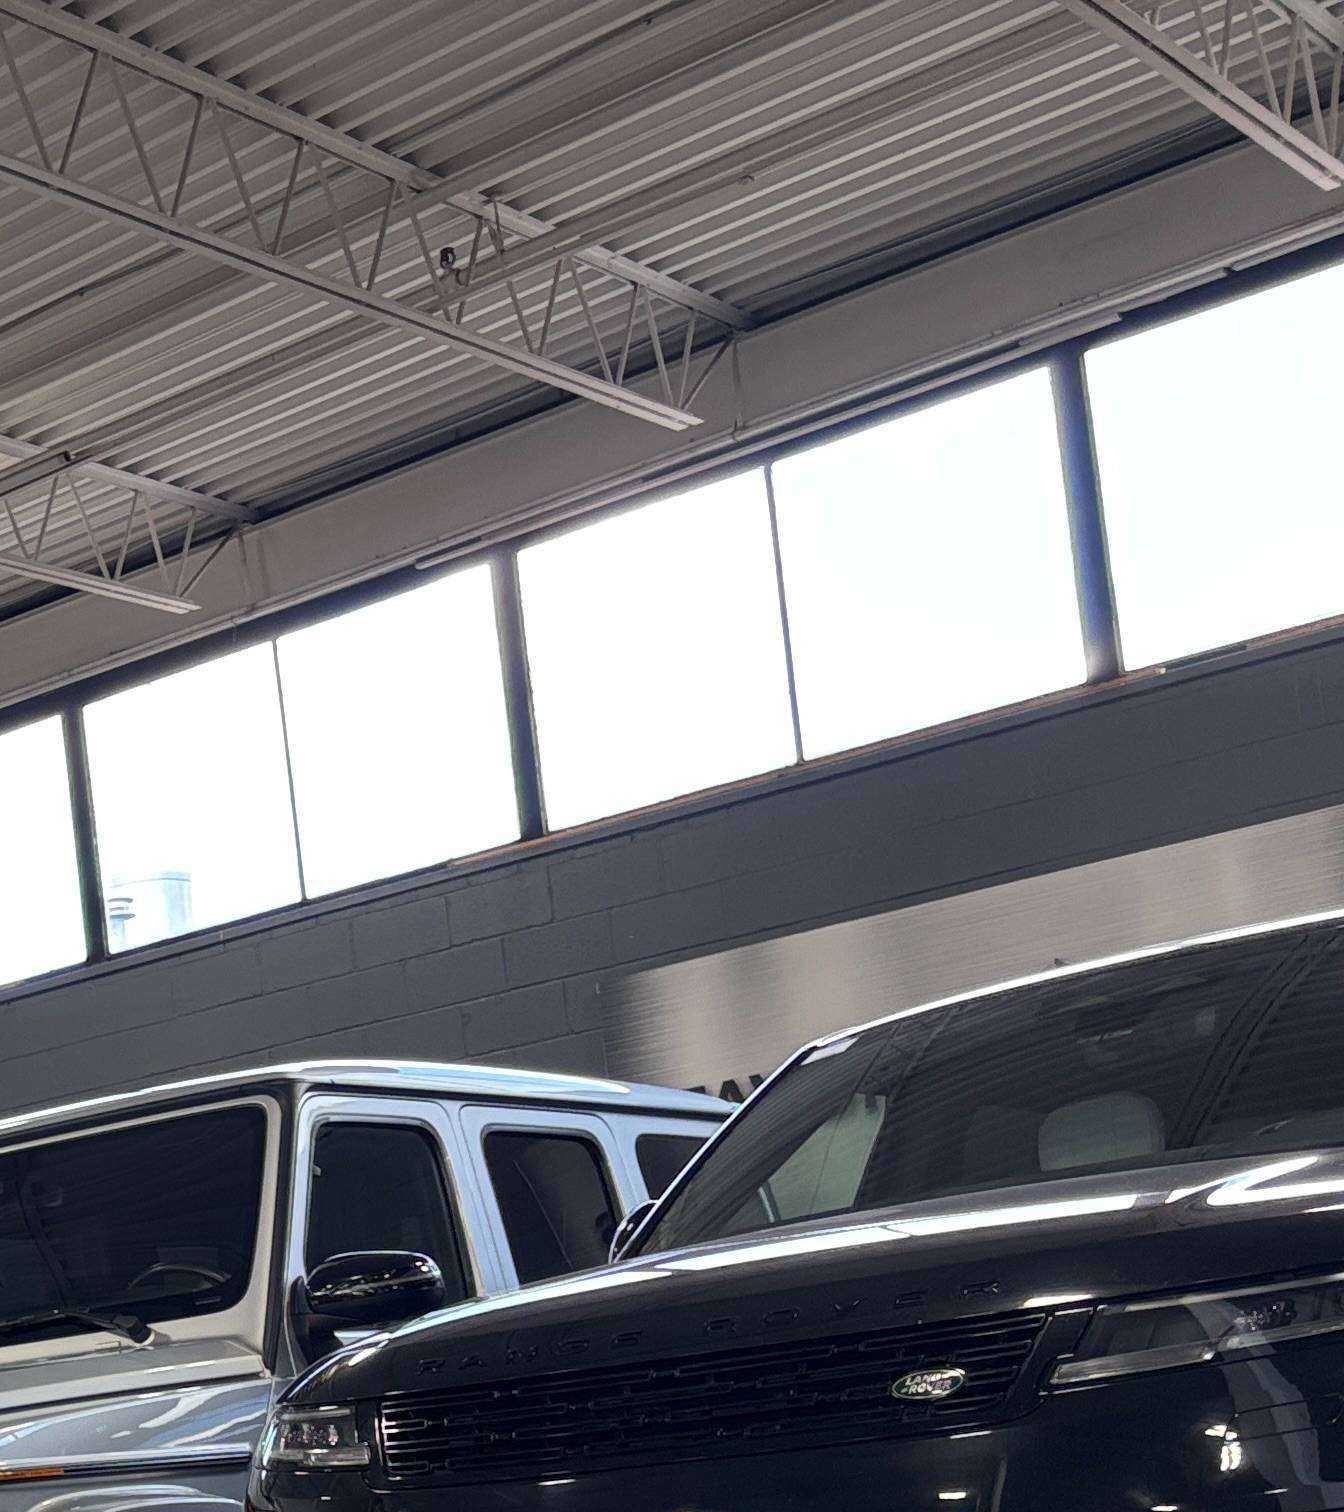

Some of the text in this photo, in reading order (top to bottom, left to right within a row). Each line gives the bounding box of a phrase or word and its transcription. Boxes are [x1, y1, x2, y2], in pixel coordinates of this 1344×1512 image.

[416, 1279, 1001, 1376] RANGE ROVER
[905, 1373, 942, 1386] LAND
